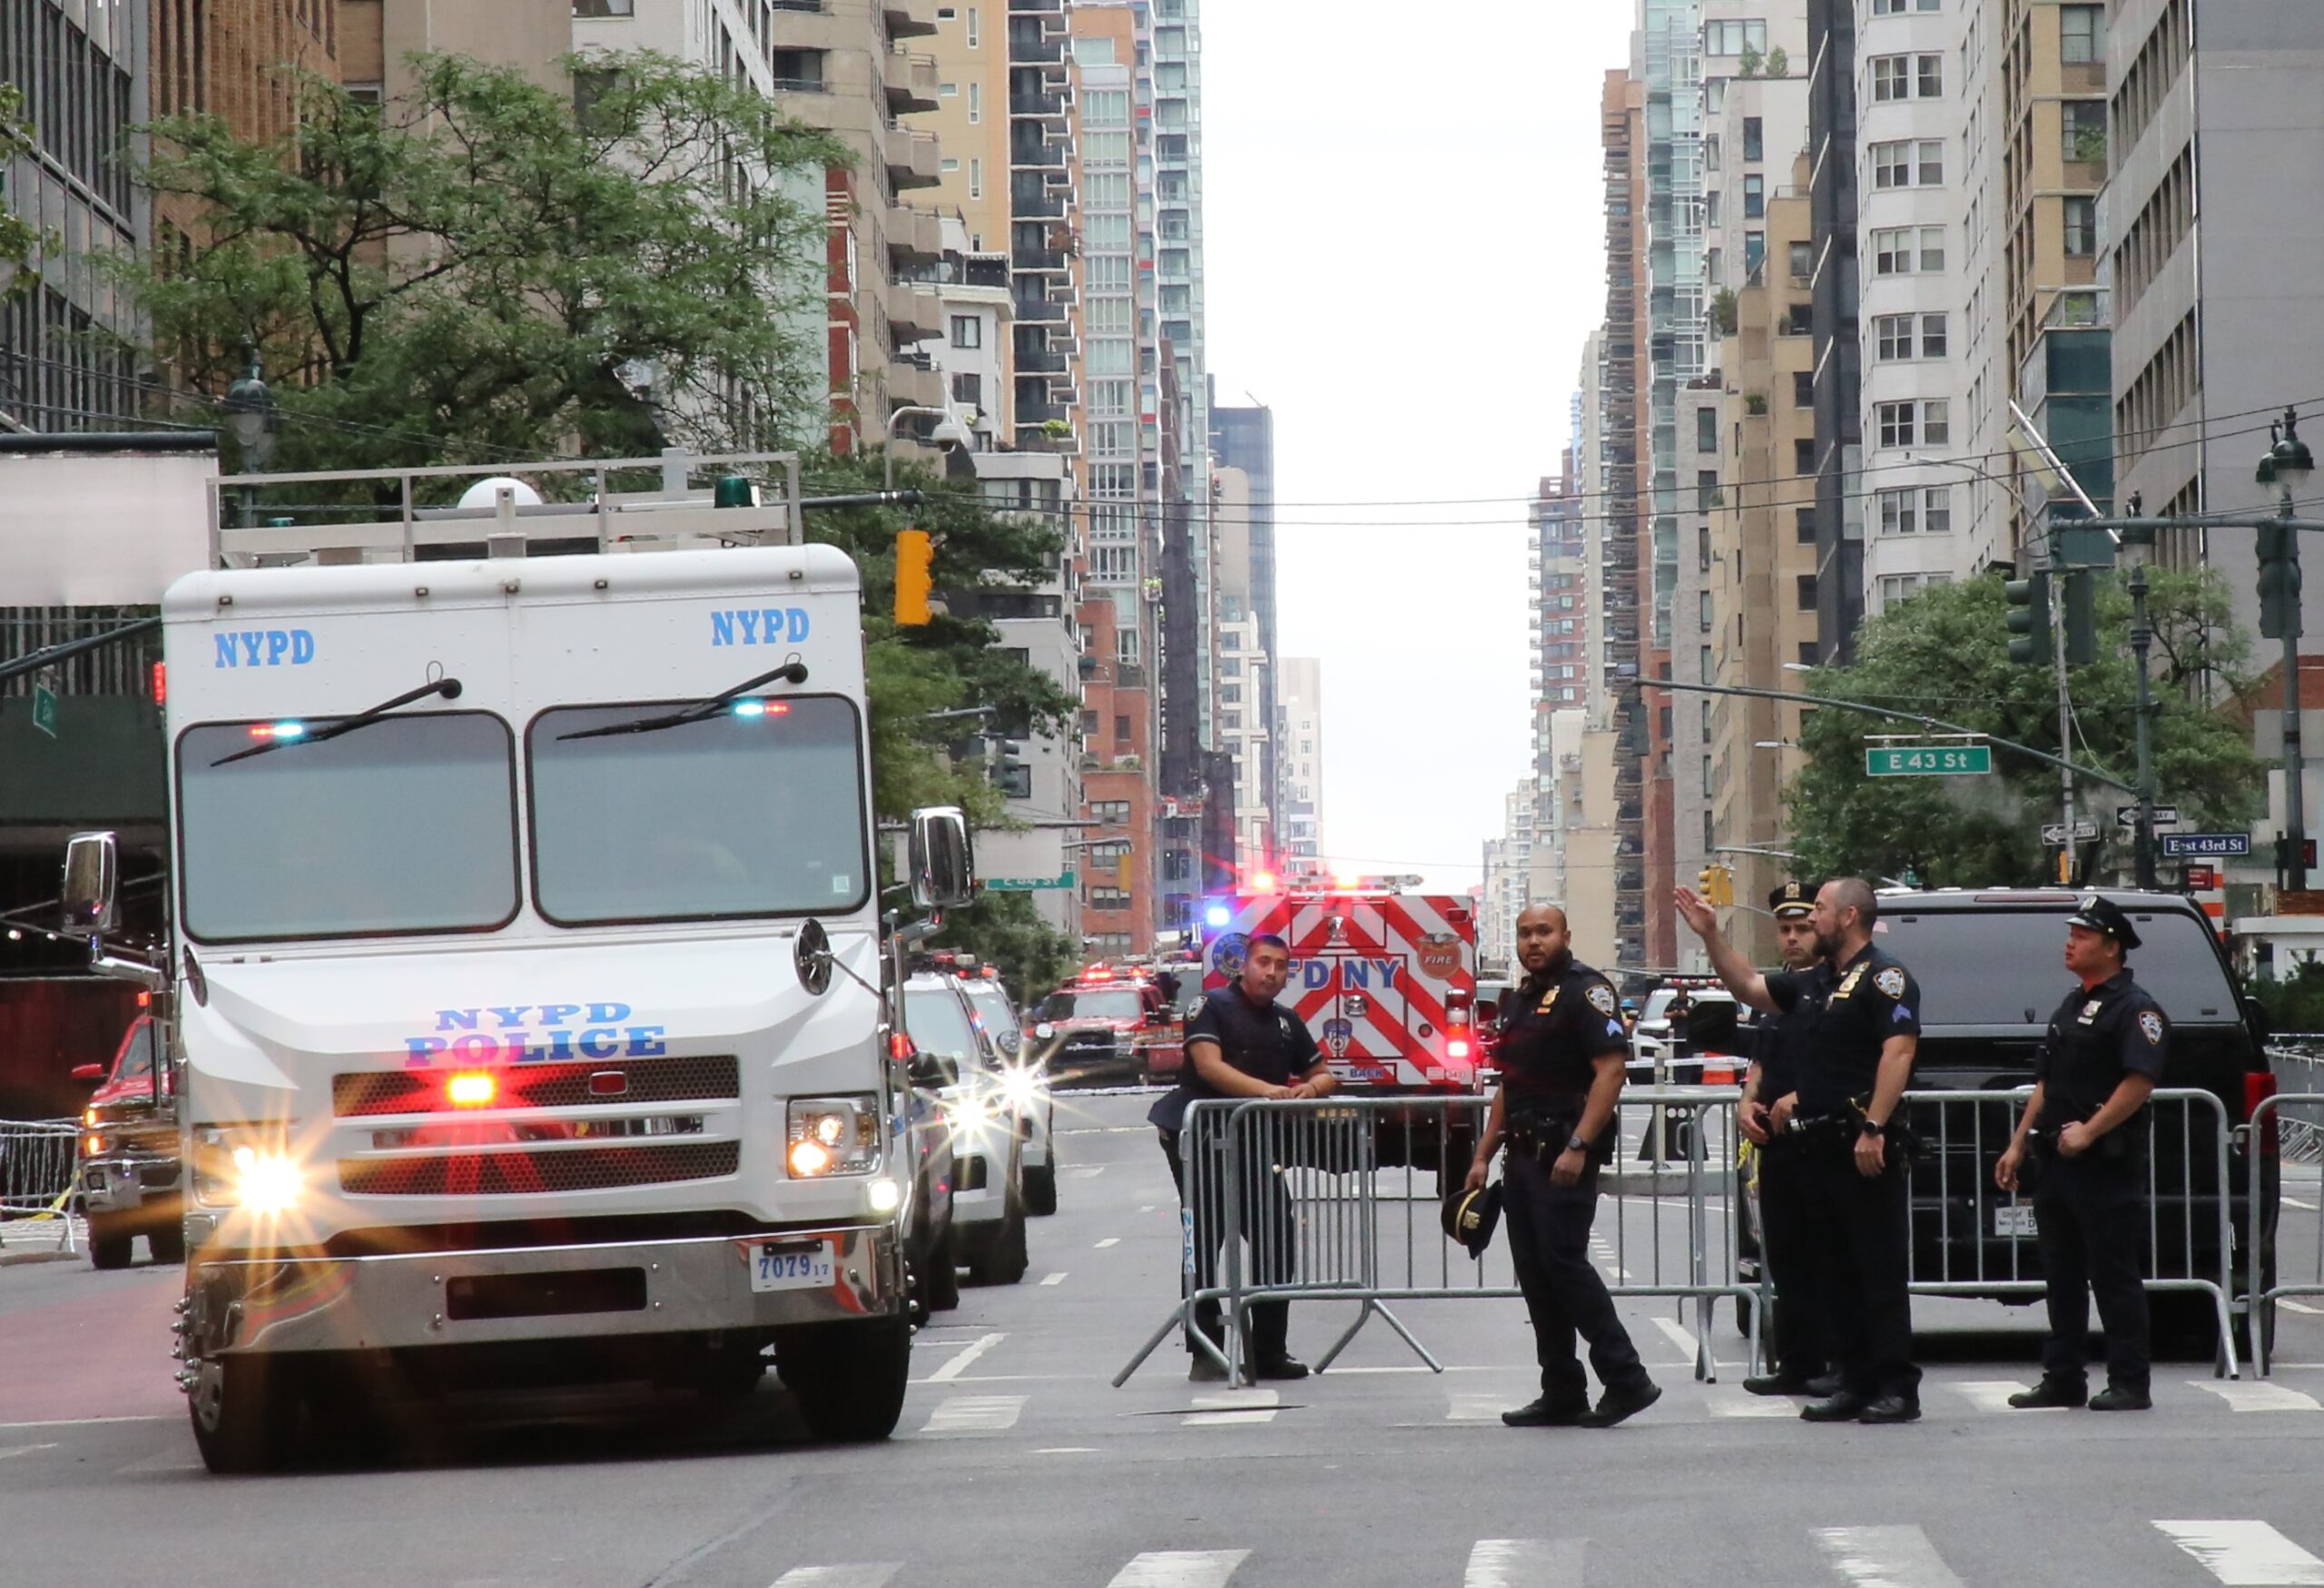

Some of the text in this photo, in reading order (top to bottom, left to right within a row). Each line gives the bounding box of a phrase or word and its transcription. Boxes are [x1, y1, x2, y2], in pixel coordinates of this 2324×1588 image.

[711, 607, 810, 646] NYPD
[213, 629, 314, 667] NYPD
[1889, 753, 1967, 769] E 43 St
[2199, 839, 2226, 852] 43rd
[2229, 838, 2242, 851] St
[1424, 955, 1452, 965] FIRE
[435, 1002, 631, 1031] NYPD
[405, 1026, 665, 1068] POLICE
[759, 1255, 829, 1279] 7079 17
